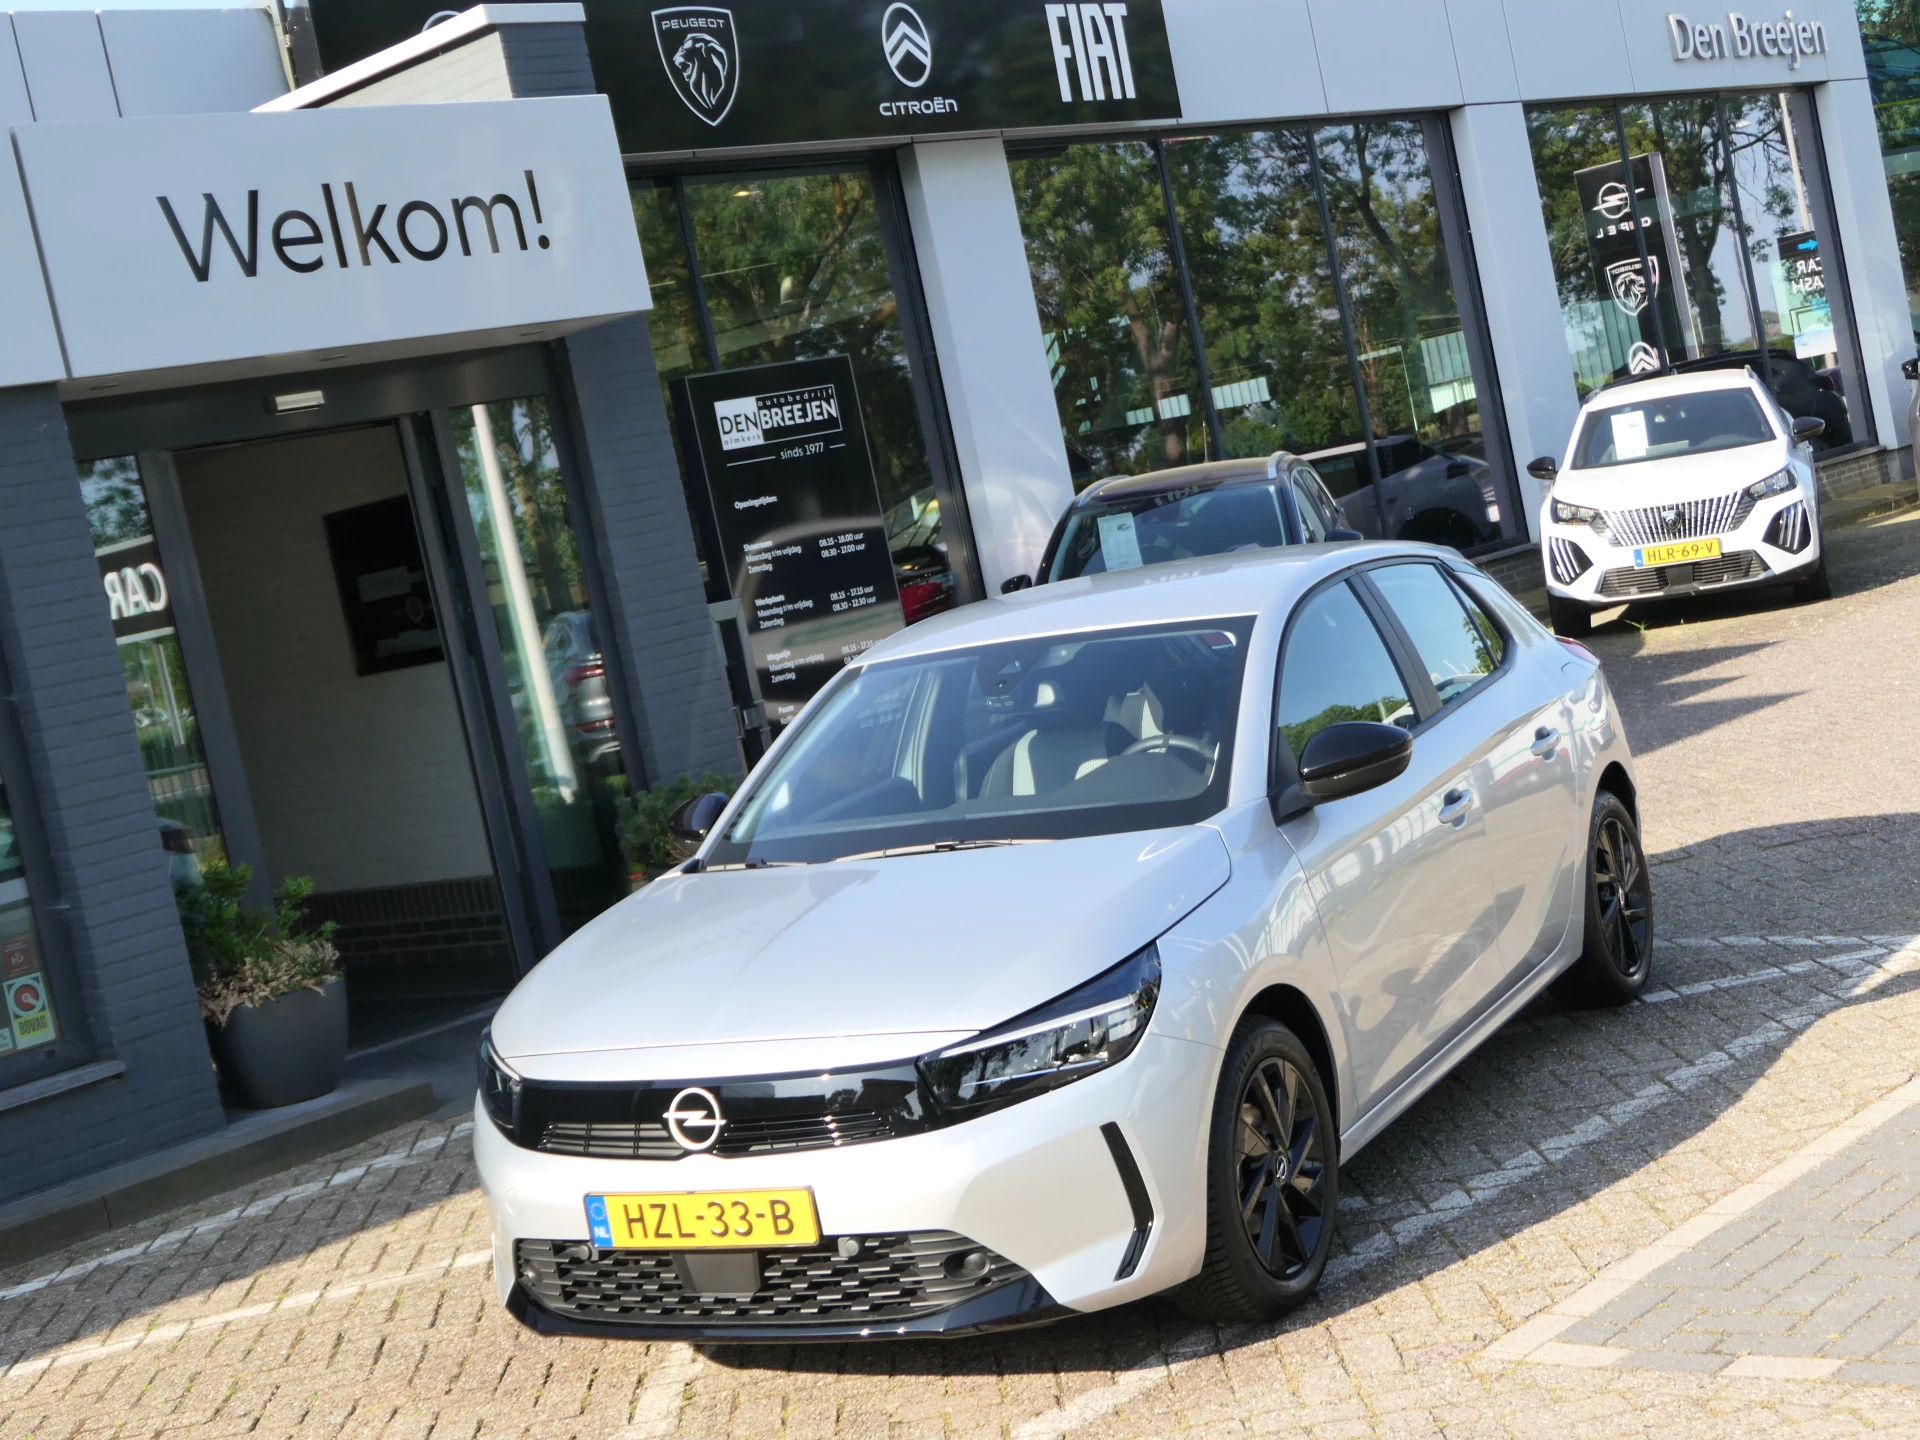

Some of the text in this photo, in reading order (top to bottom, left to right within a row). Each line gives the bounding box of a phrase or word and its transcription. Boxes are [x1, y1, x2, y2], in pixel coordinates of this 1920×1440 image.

[661, 18, 725, 31] PEUGEOT
[1665, 9, 1829, 71] Den Breejen
[1044, 3, 1136, 103] FIAT
[878, 97, 958, 116] CITROËN
[155, 169, 551, 283] Welkom!
[757, 387, 833, 408] autobedrijf
[720, 398, 838, 436] DEN BREEJEN
[780, 442, 825, 460] sinds 1977
[1646, 542, 1713, 562] HLR-69-V
[18, 1014, 48, 1036] BOVAG
[594, 1198, 795, 1239] NL HZL-33-B
